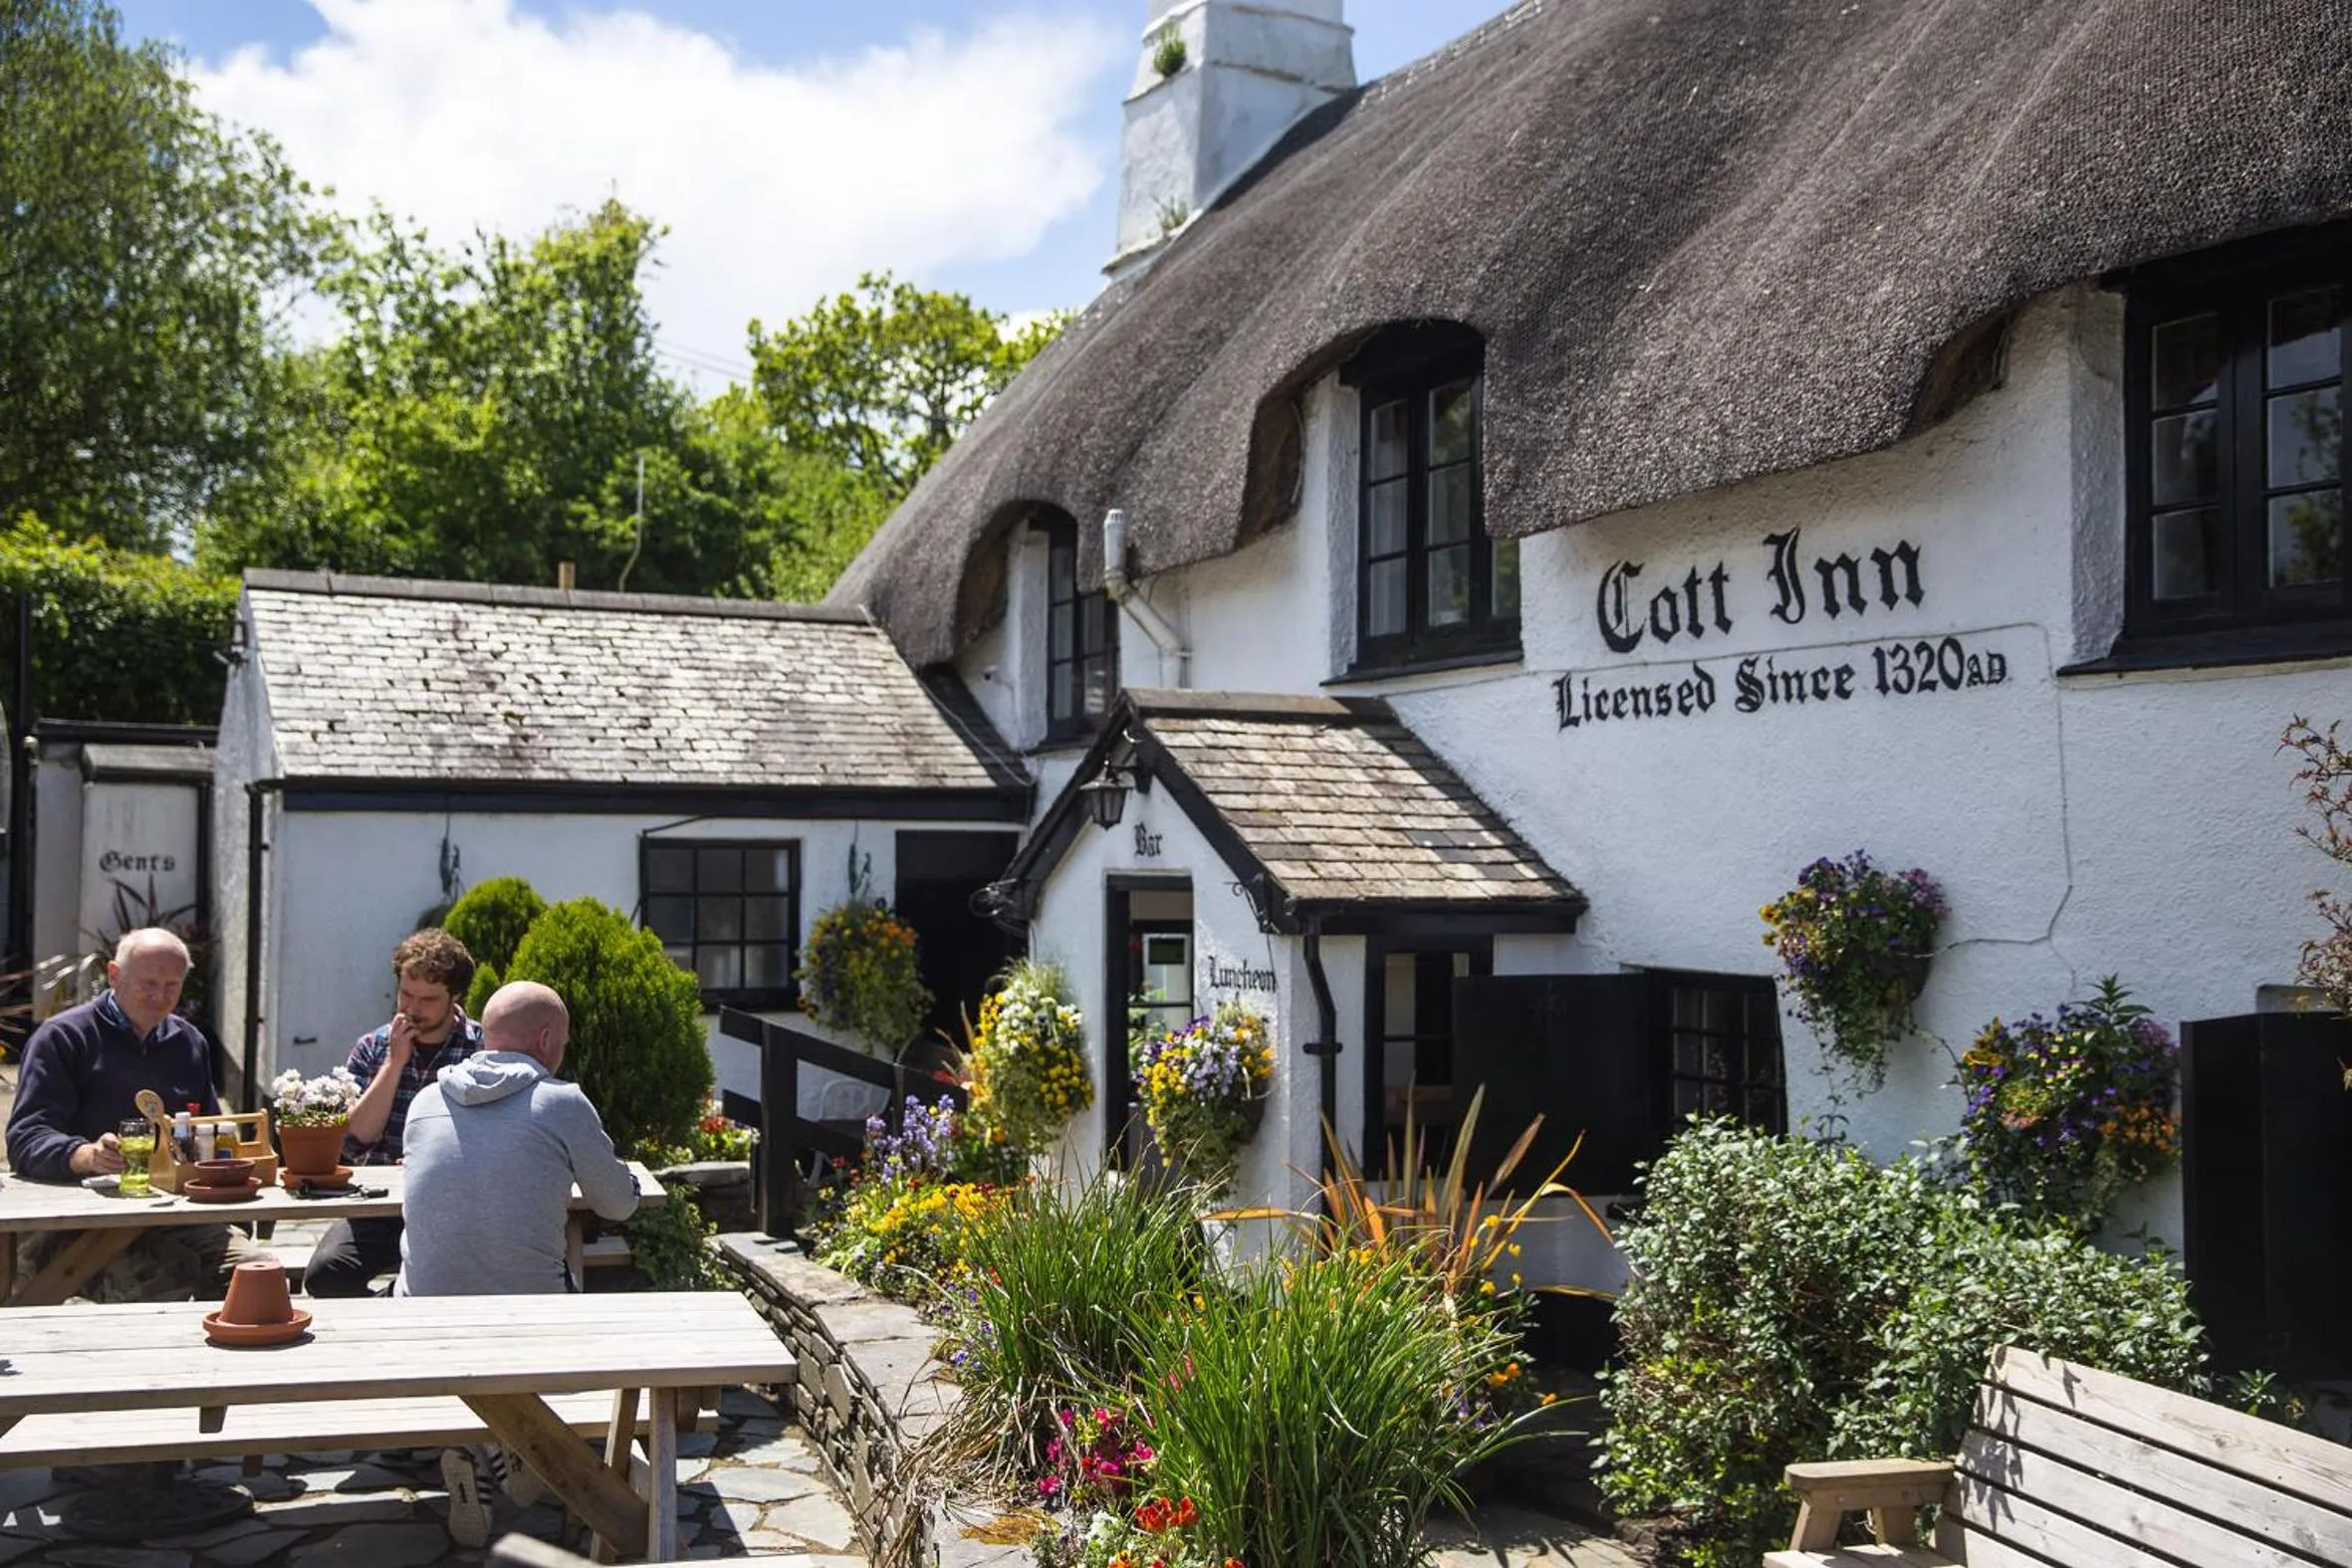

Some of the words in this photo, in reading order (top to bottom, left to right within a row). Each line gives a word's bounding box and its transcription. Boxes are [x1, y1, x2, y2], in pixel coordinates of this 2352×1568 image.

[1596, 559, 1735, 654] Cott
[1763, 526, 1926, 625] Inn
[1550, 660, 1717, 734] Licensed
[1734, 654, 1856, 714] Since
[1133, 821, 1163, 857] Bar
[99, 850, 176, 873] Gents
[1208, 955, 1277, 994] Luncheon
